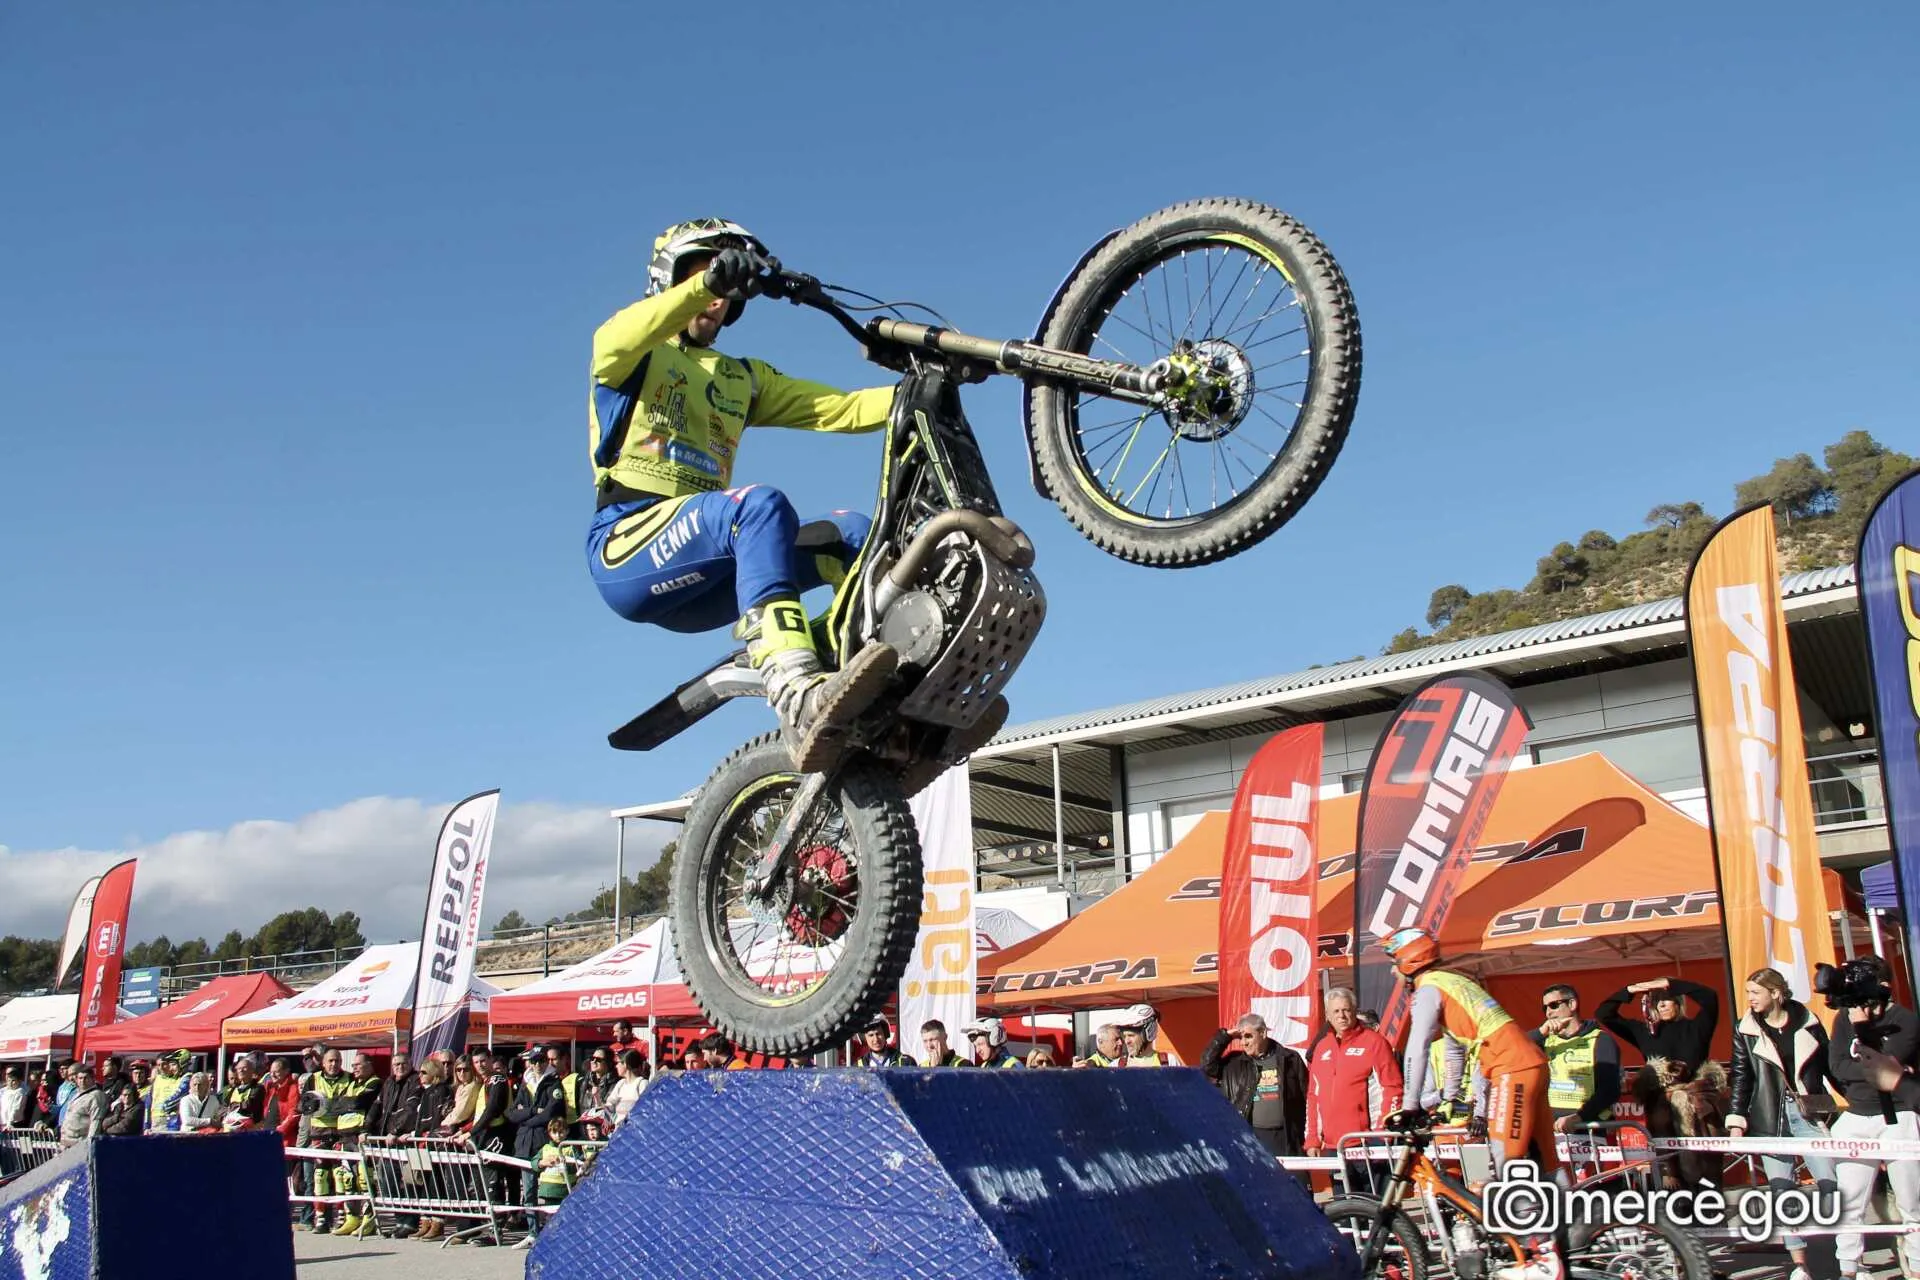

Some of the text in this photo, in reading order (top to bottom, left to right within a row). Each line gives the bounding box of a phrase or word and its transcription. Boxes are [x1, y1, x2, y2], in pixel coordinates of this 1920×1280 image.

[650, 508, 701, 570] KENNY
[651, 571, 706, 596] GALFER
[1369, 690, 1506, 938] COMAS
[1716, 583, 1811, 1004] CORPA
[431, 817, 474, 985] REPSOL
[466, 859, 485, 948] HONDA
[1248, 781, 1313, 1062] MOTUL
[1487, 890, 1720, 938] SCORP
[292, 995, 370, 1010] HONDA
[577, 991, 648, 1011] GASGAS
[975, 956, 1160, 995] SCORPA
[1510, 1083, 1525, 1140] COMAS
[1811, 1138, 1881, 1158] octagon
